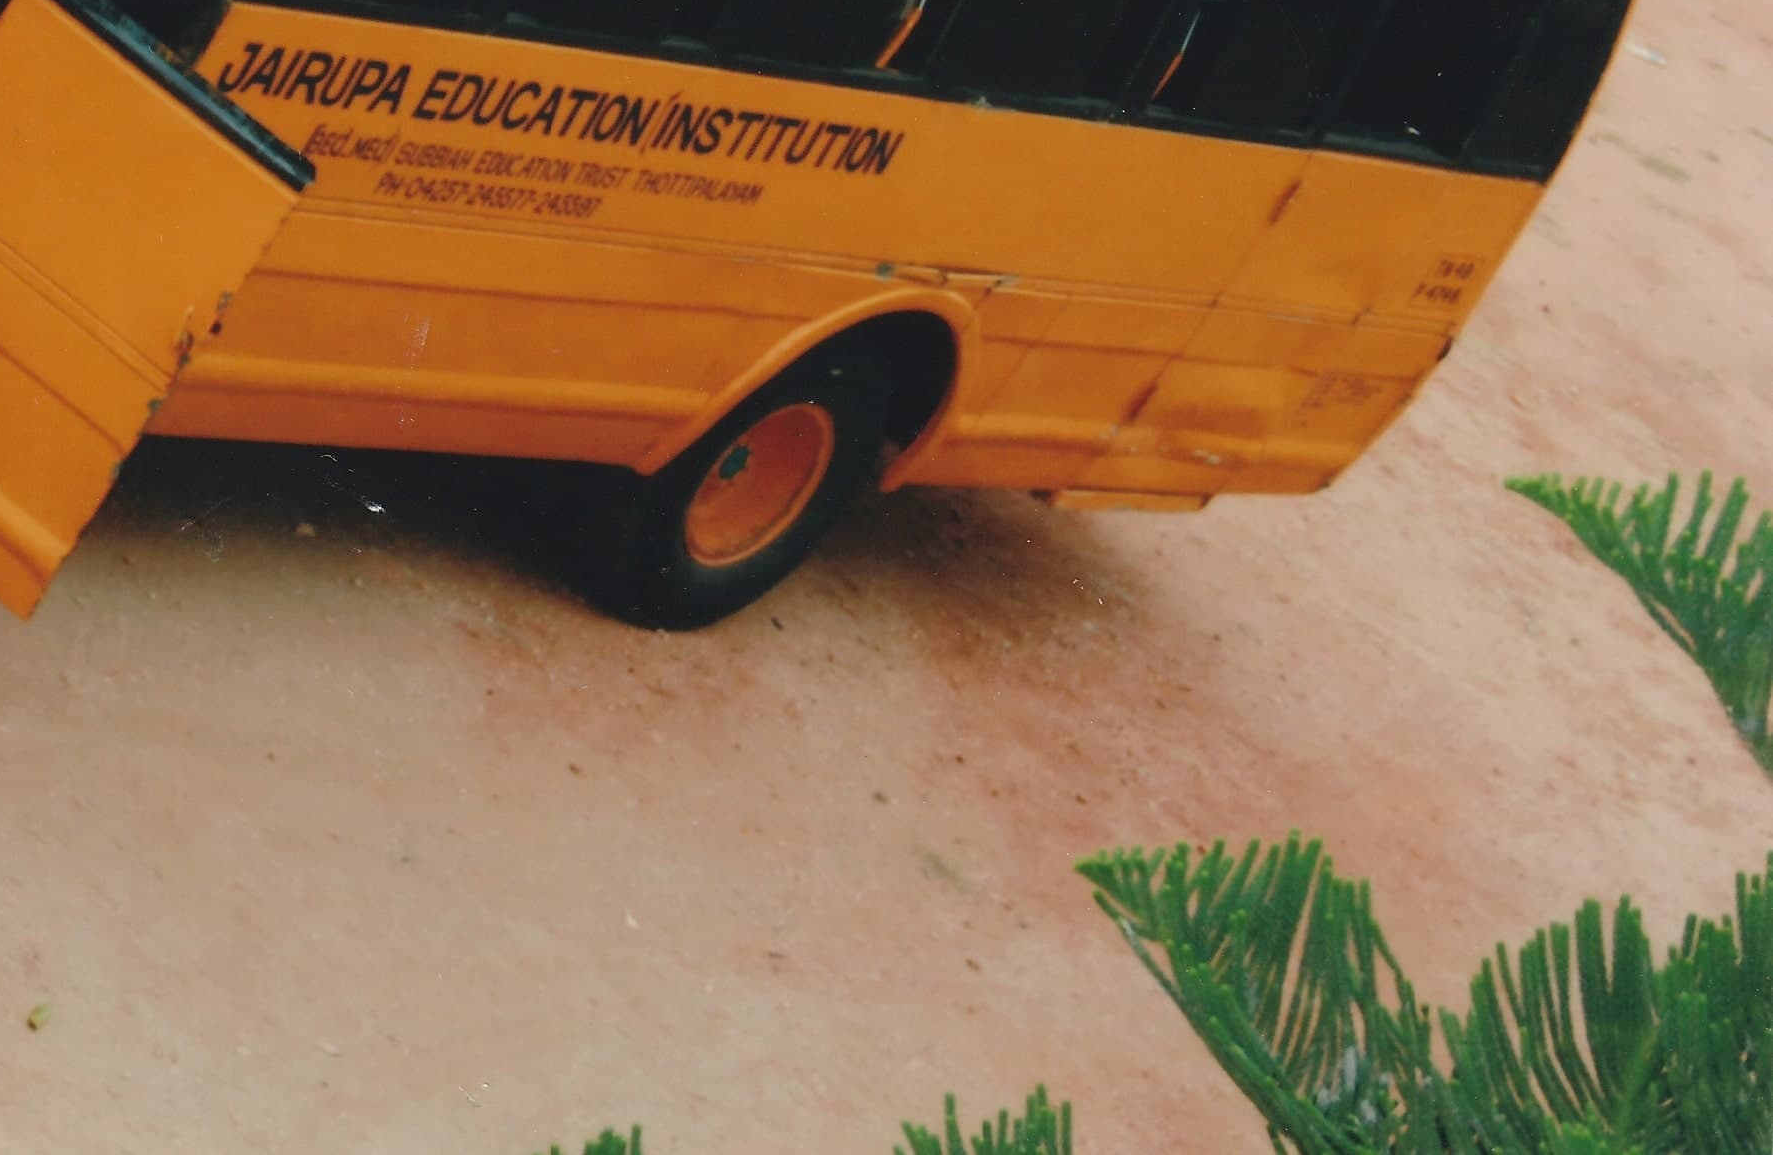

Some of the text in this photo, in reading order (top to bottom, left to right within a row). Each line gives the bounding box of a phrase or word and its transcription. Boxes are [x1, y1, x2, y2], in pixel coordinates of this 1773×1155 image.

[216, 42, 905, 175] JAIRUPA EDUCATION INSTITUTION
